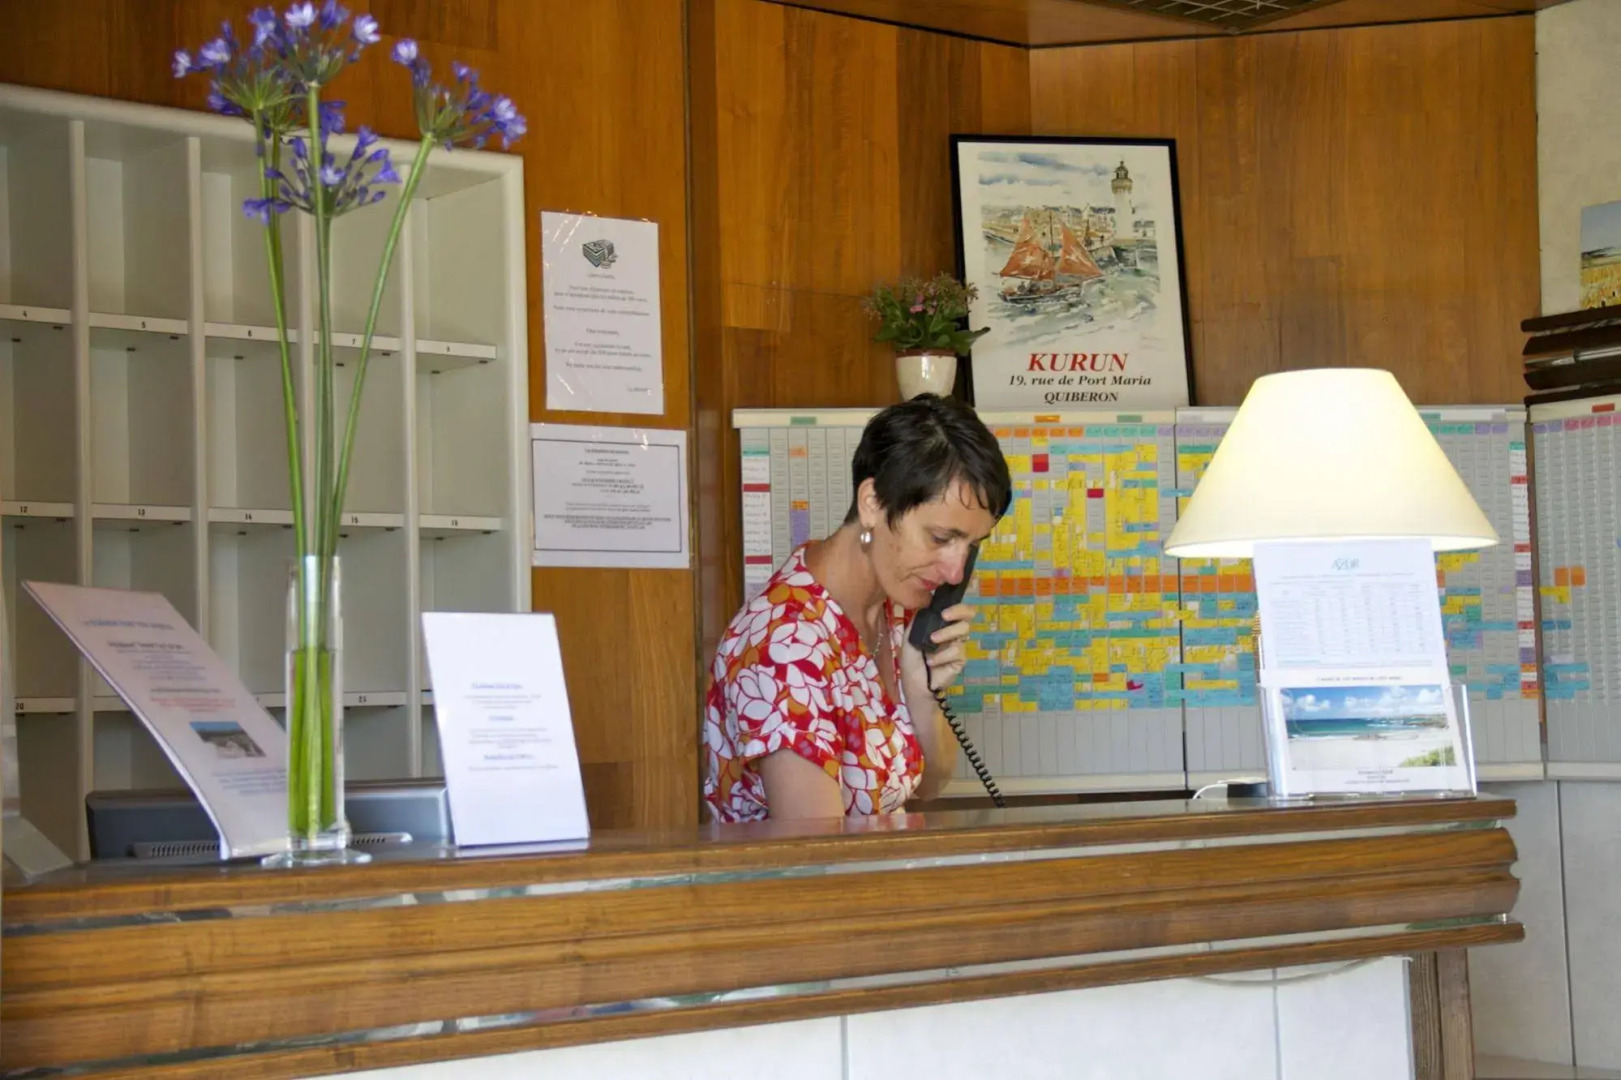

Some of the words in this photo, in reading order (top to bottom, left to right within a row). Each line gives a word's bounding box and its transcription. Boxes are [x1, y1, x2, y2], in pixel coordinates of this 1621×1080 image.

[1027, 353, 1129, 372] KURUN
[1031, 377, 1054, 386] rue
[1058, 375, 1074, 386] de
[1078, 375, 1107, 386] Port
[1110, 375, 1152, 386] Maria
[1044, 391, 1119, 405] QUIBERON
[19, 505, 28, 513] 12
